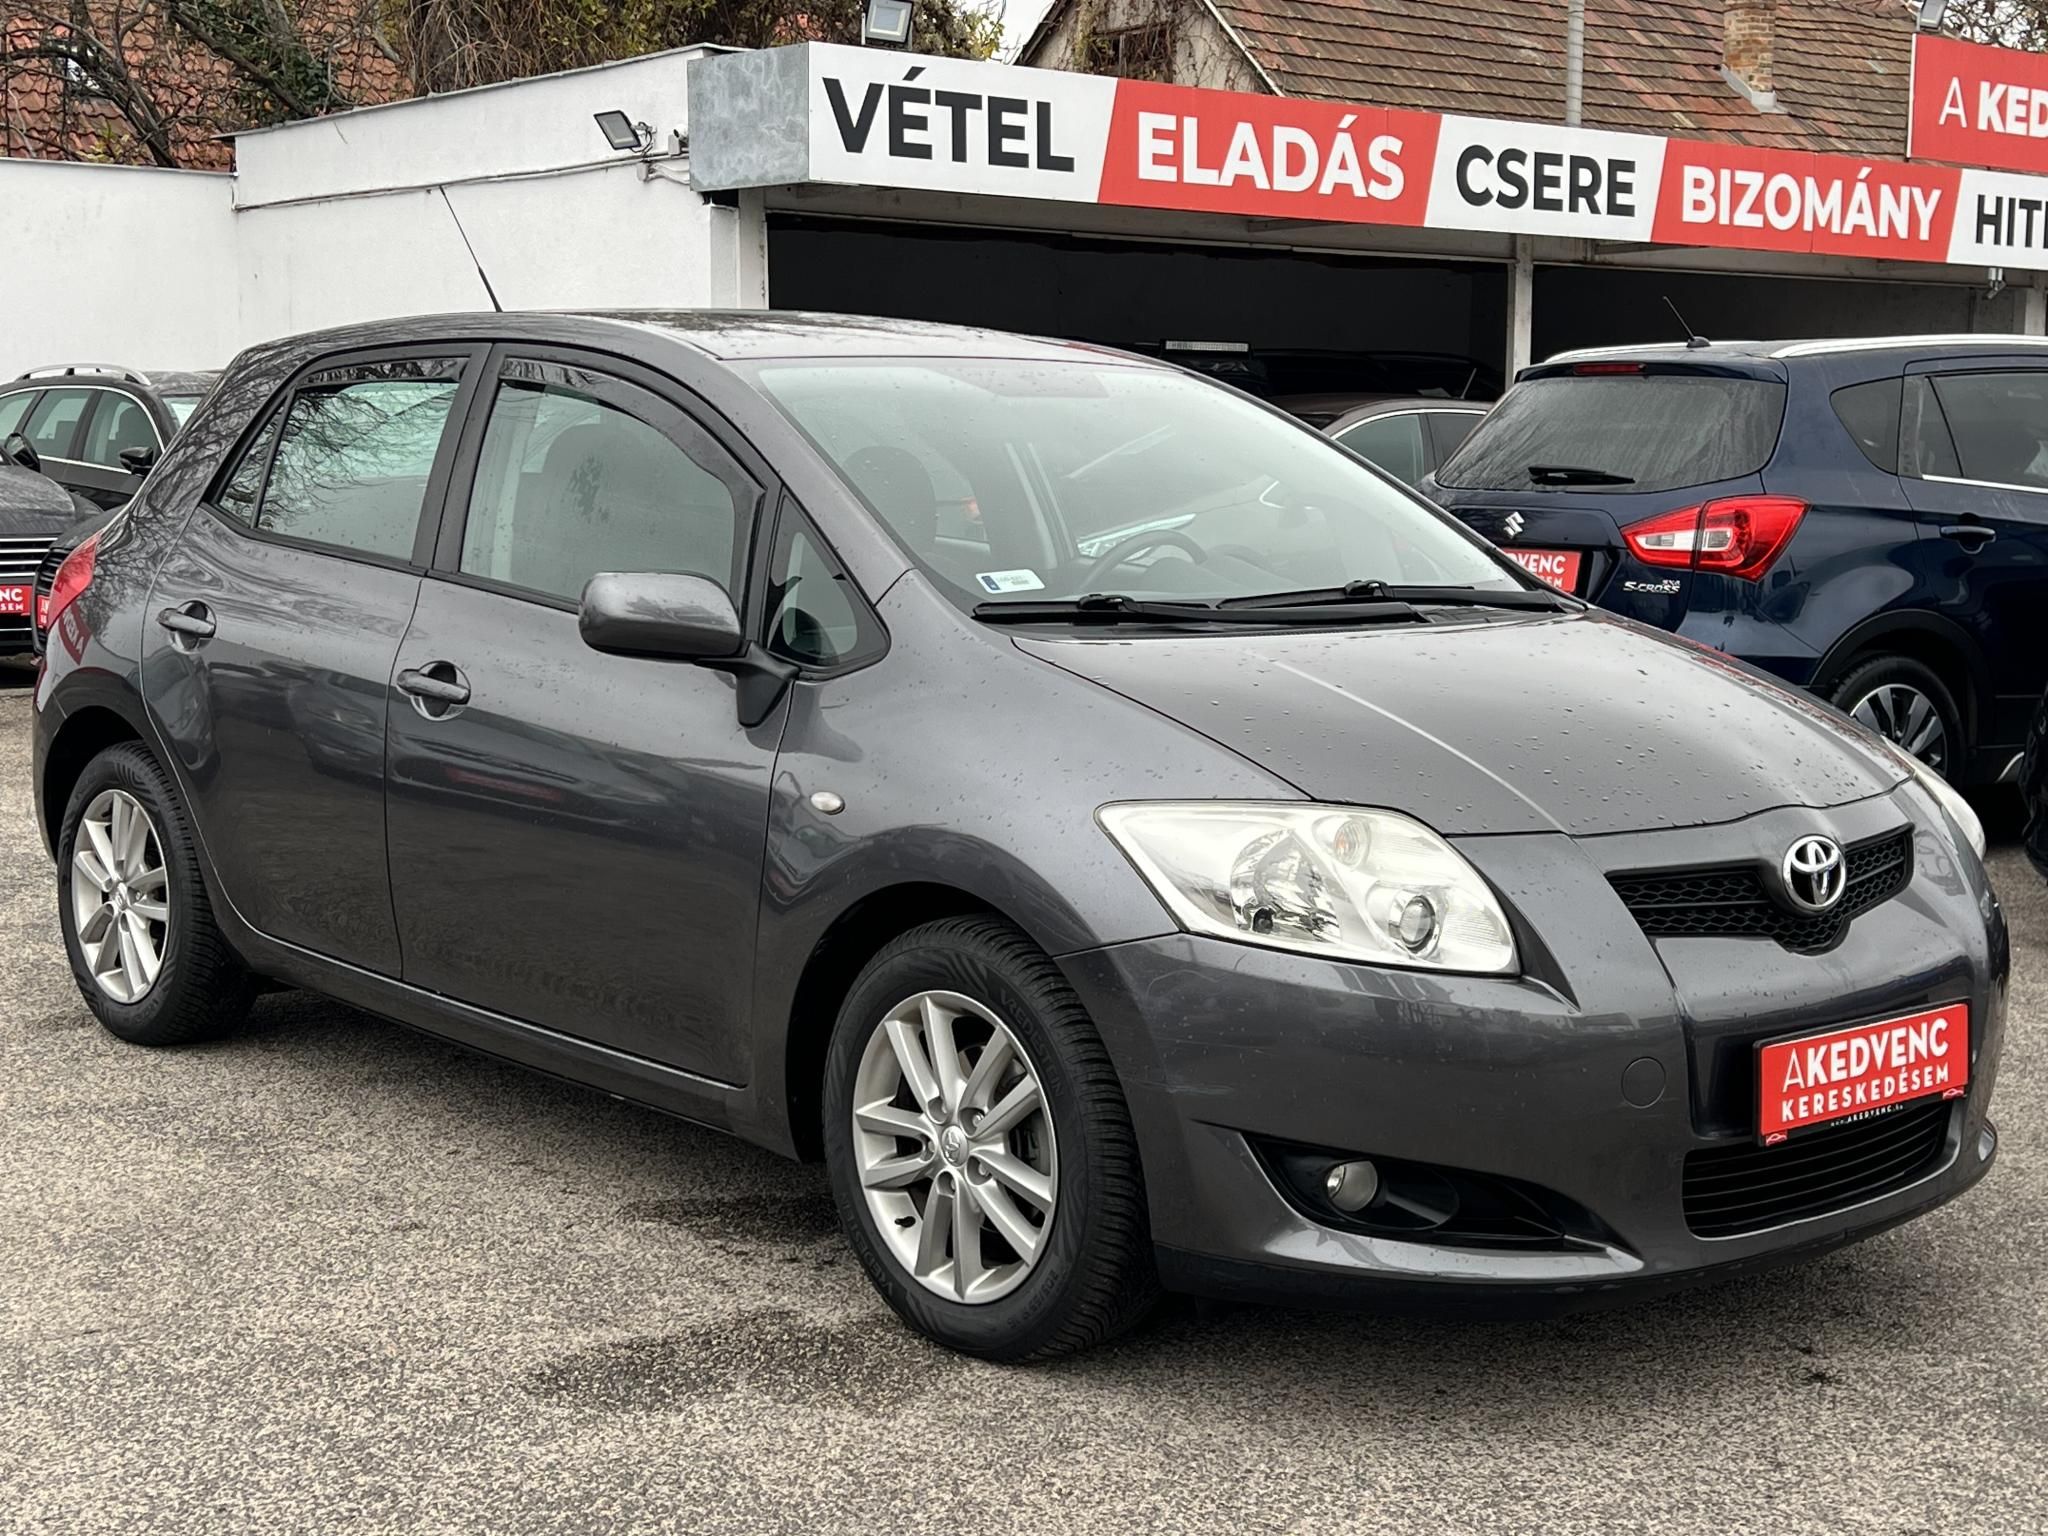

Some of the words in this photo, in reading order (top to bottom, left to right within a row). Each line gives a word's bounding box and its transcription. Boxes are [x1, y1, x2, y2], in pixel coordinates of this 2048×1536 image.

[1938, 76, 1967, 128] A
[822, 66, 1075, 173] VÉTEL
[1138, 113, 1405, 201] ELADÁS
[1456, 144, 1636, 218] CSERE
[1682, 165, 1942, 241] BIZOMÁNY
[1781, 1062, 1949, 1122] KERESKEDÉSEM
